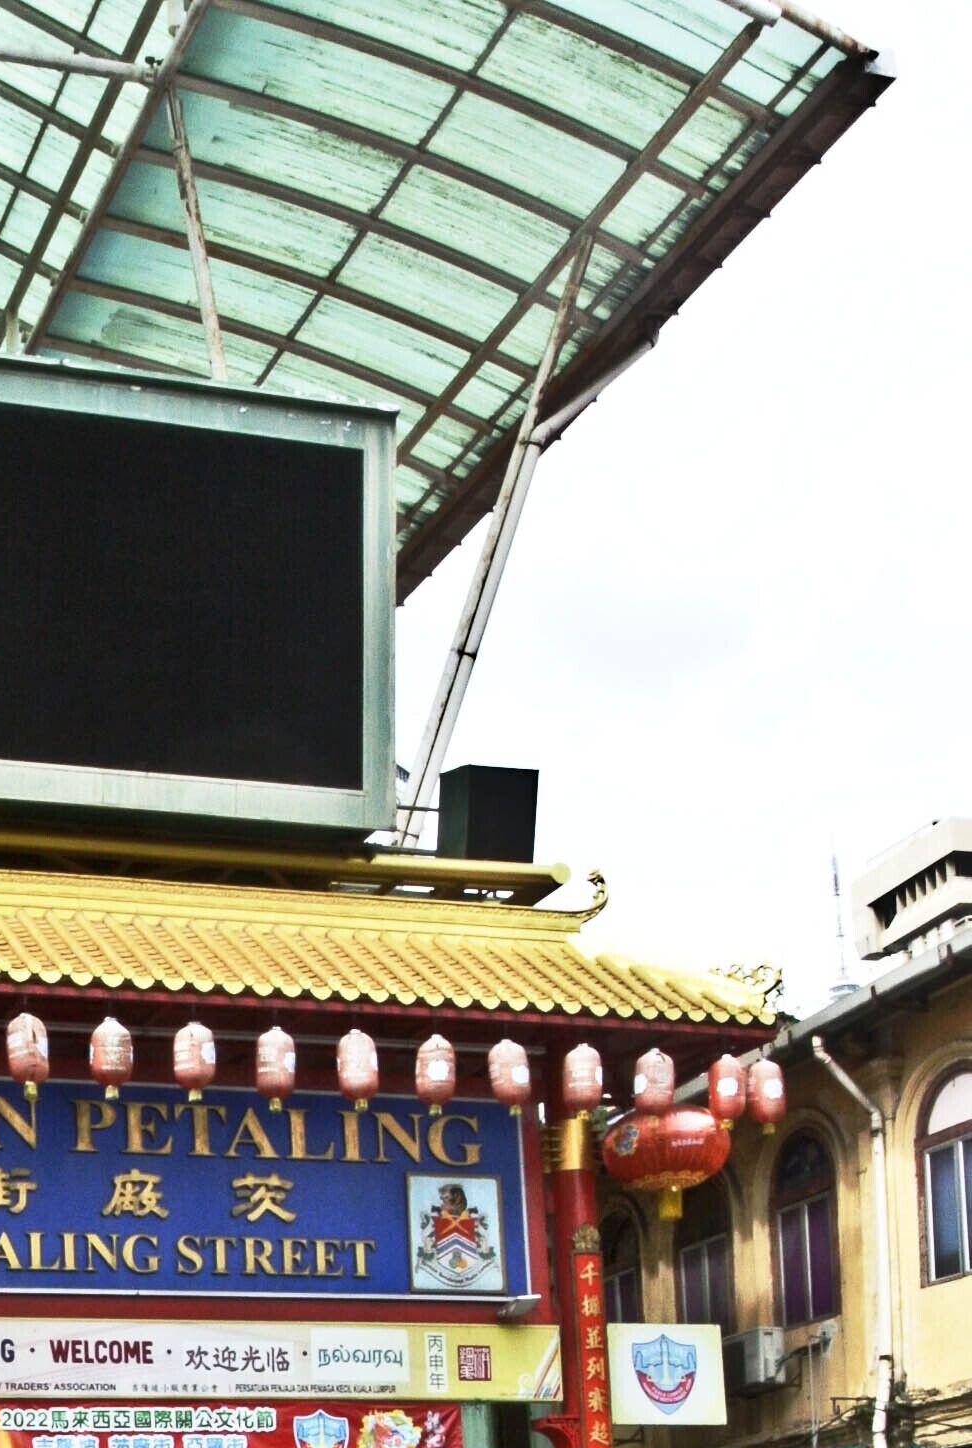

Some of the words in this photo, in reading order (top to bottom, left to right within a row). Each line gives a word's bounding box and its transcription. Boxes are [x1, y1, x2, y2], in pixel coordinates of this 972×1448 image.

[71, 1098, 484, 1167] PETALING
[177, 1234, 376, 1279] STREET
[50, 1340, 154, 1364] WELCOME
[184, 1345, 290, 1373] 欢迎光临
[318, 1344, 404, 1368] நல்வரவு
[53, 1382, 117, 1392] ASSOCIATION
